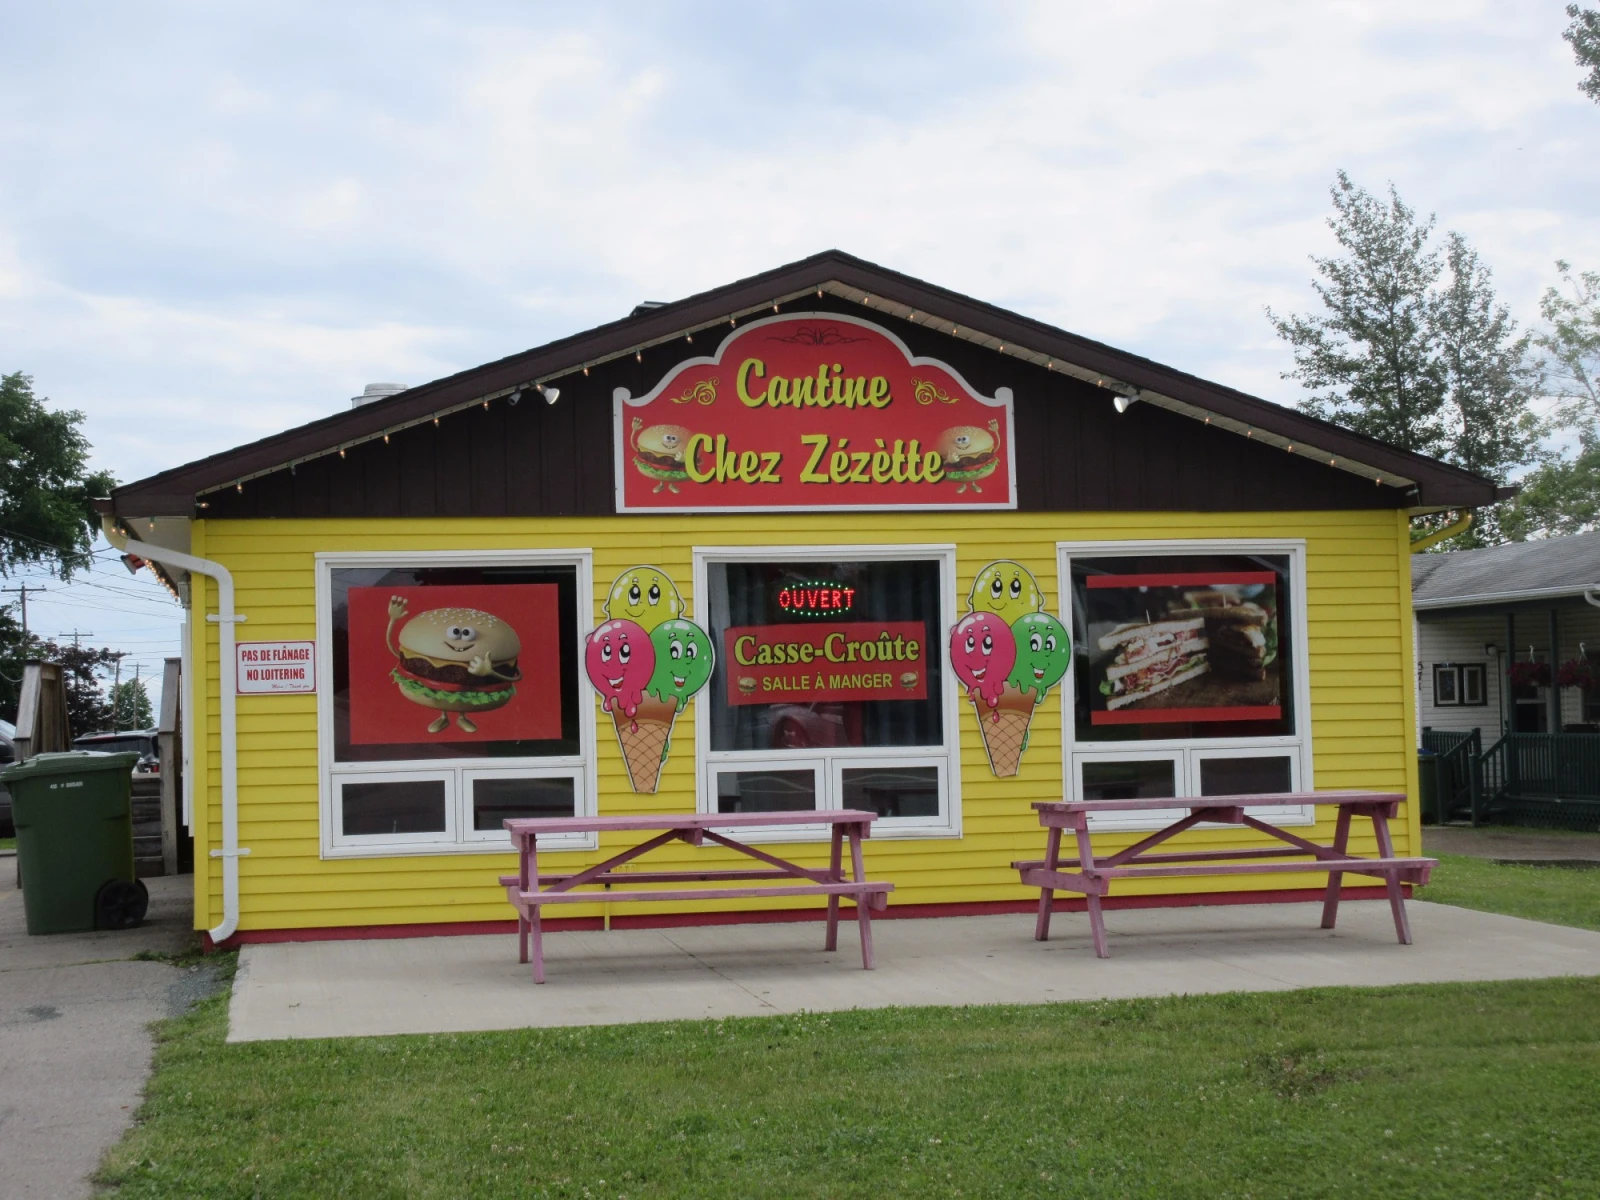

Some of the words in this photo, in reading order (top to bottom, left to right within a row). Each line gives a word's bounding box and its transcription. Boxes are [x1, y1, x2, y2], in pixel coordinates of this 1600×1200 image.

[737, 358, 892, 408] Cantine
[685, 433, 782, 483] Chez
[800, 433, 946, 484] Zézètte
[779, 589, 855, 608] OUVERT
[242, 650, 258, 661] PAS
[260, 649, 271, 661] DE
[273, 645, 310, 661] FLÂNAGE
[734, 631, 920, 666] Casse-Croûte
[247, 669, 258, 681] NO
[261, 668, 305, 681] LOITERING
[762, 674, 810, 691] SALLE
[814, 672, 825, 690] À
[829, 673, 893, 690] MANGER
